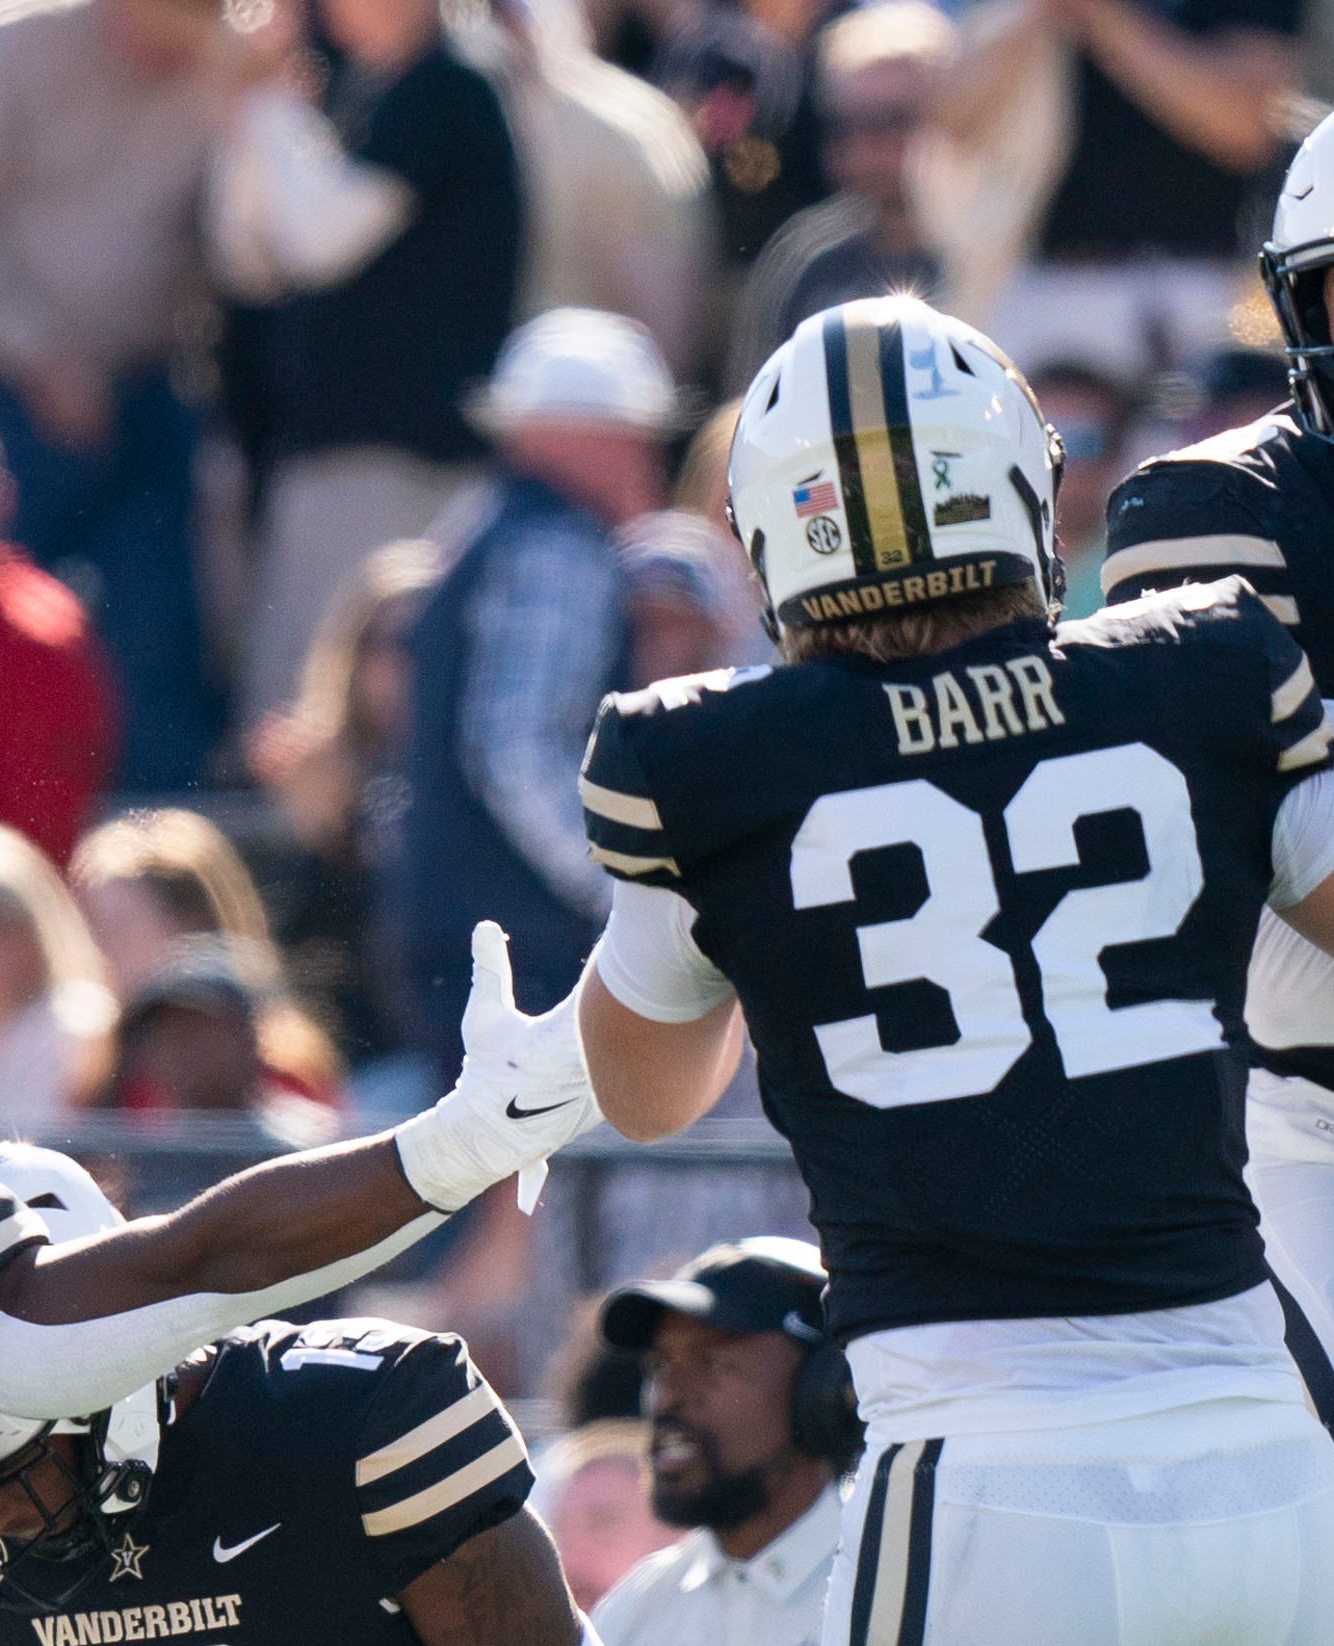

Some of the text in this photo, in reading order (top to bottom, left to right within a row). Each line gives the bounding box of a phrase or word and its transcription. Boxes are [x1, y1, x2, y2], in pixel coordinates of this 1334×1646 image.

[808, 518, 841, 554] SEC
[880, 551, 904, 565] 32
[801, 560, 997, 622] VANDERBILT
[882, 655, 1065, 756] BARR
[790, 742, 1230, 1110] 32
